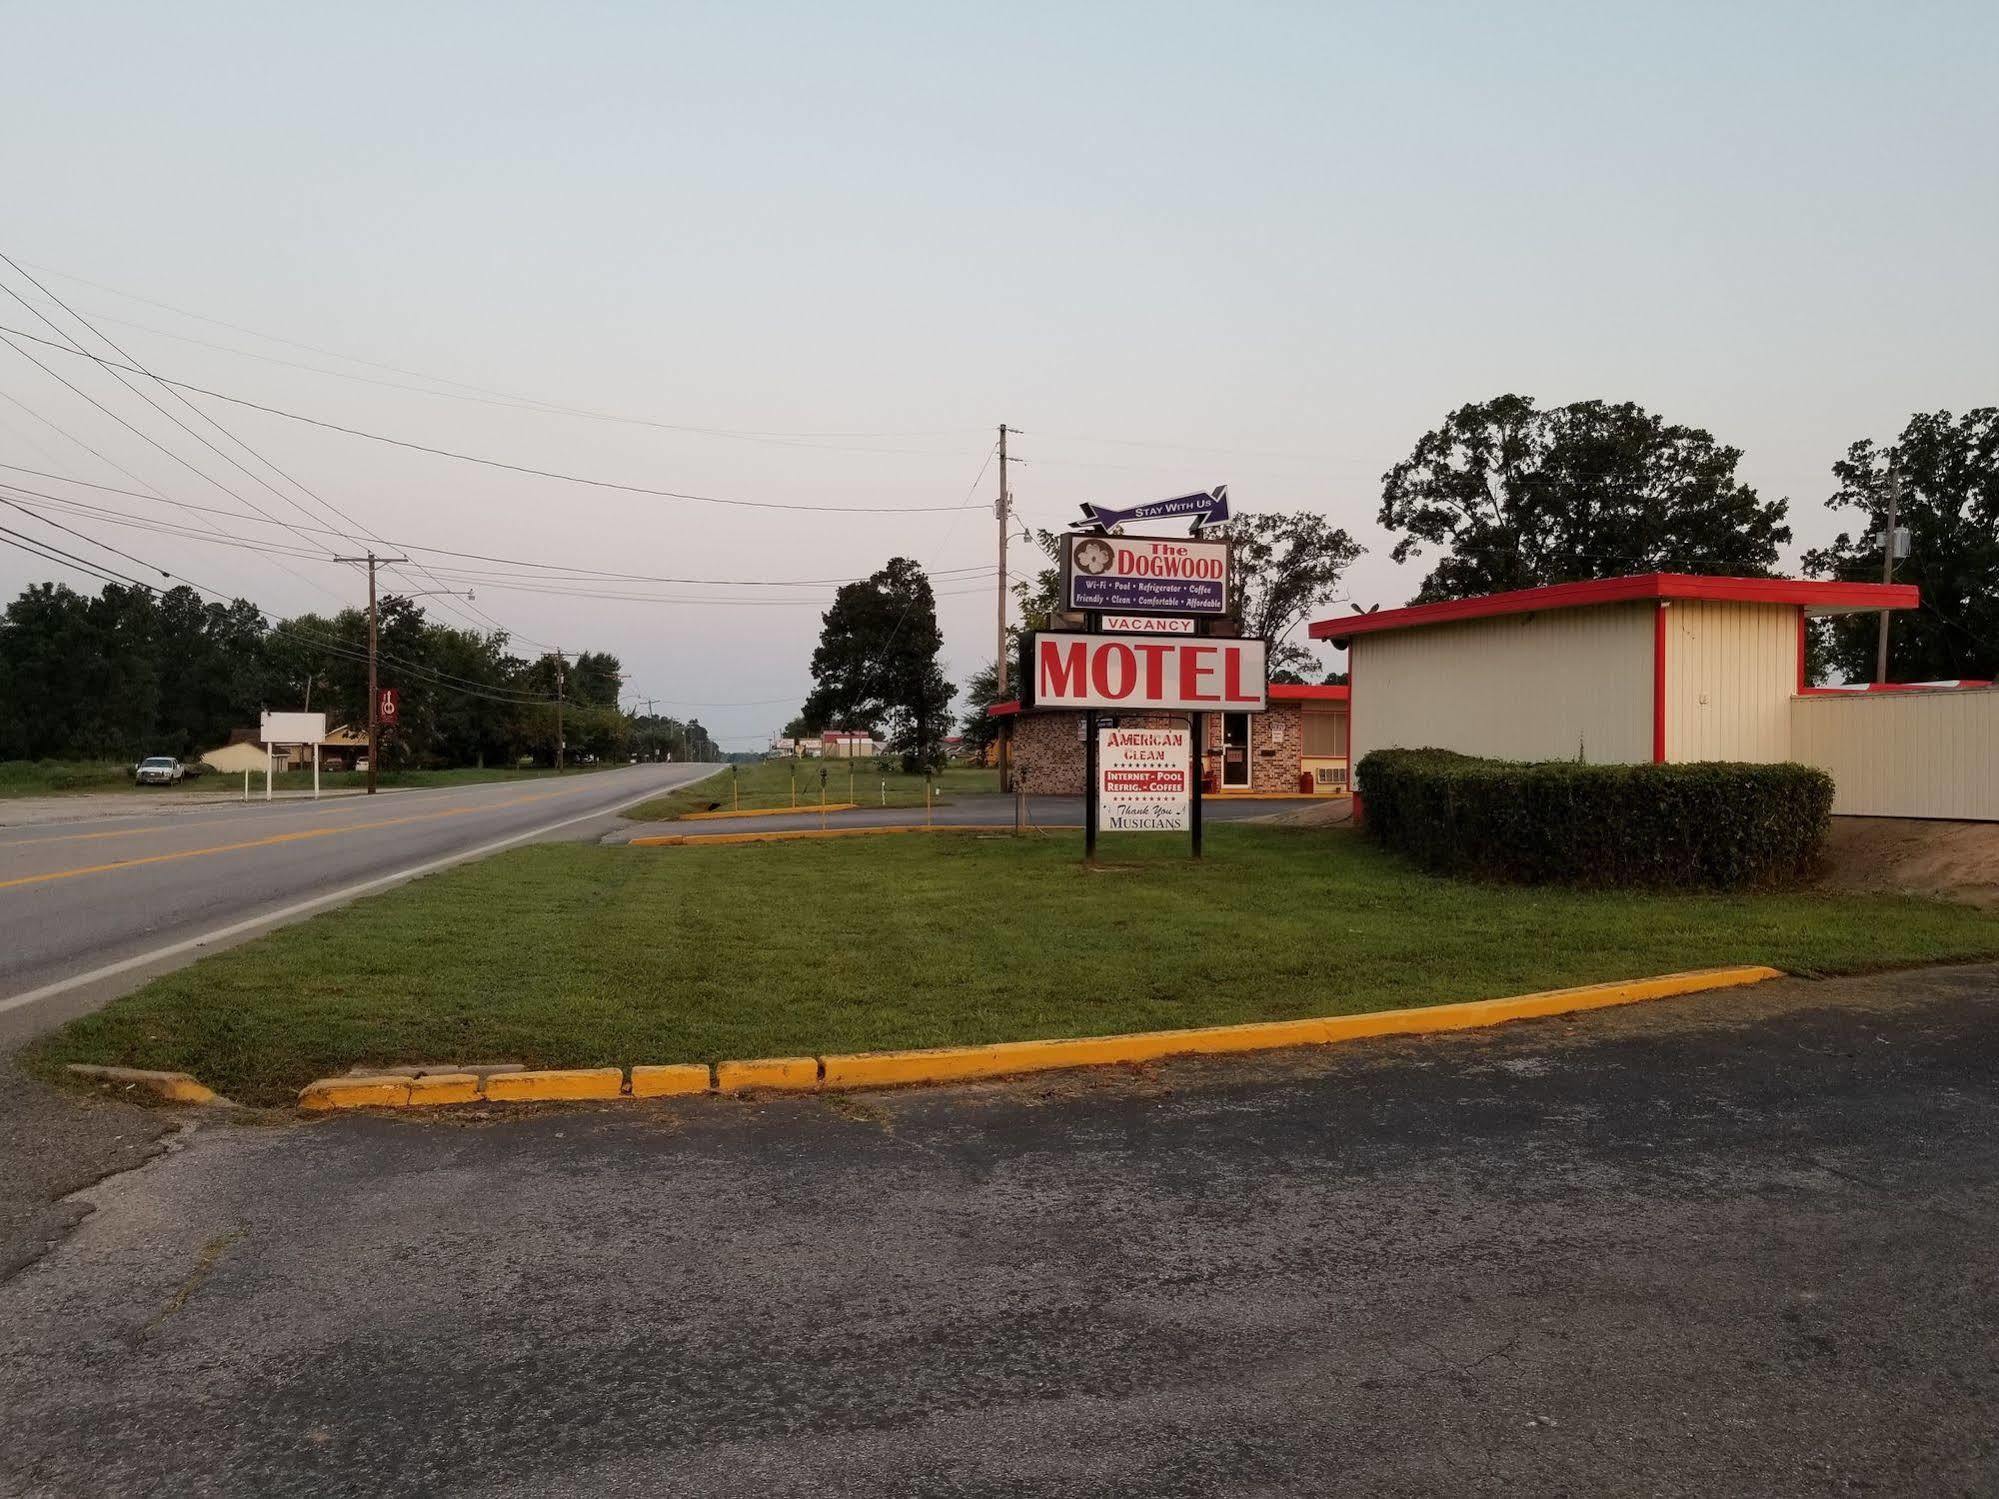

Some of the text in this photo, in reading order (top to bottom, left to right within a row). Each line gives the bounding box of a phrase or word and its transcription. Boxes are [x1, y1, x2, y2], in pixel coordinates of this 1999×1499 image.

[1151, 544, 1188, 556] The
[1118, 550, 1223, 579] DOGWOOD
[1085, 580, 1212, 595] Wi-Fi Pool Refrigerator Coffee
[1076, 593, 1221, 608] Friendly Clean Comfortable Affordable
[1108, 618, 1191, 632] VACANCY
[1041, 641, 1260, 702] MOTEL
[1107, 733, 1182, 747] AMERICAN
[1107, 771, 1183, 781] INTERNET POOL
[1149, 783, 1183, 792] COFFEE
[1117, 804, 1172, 818] Thank You
[1110, 817, 1181, 829] MUSICIANS
